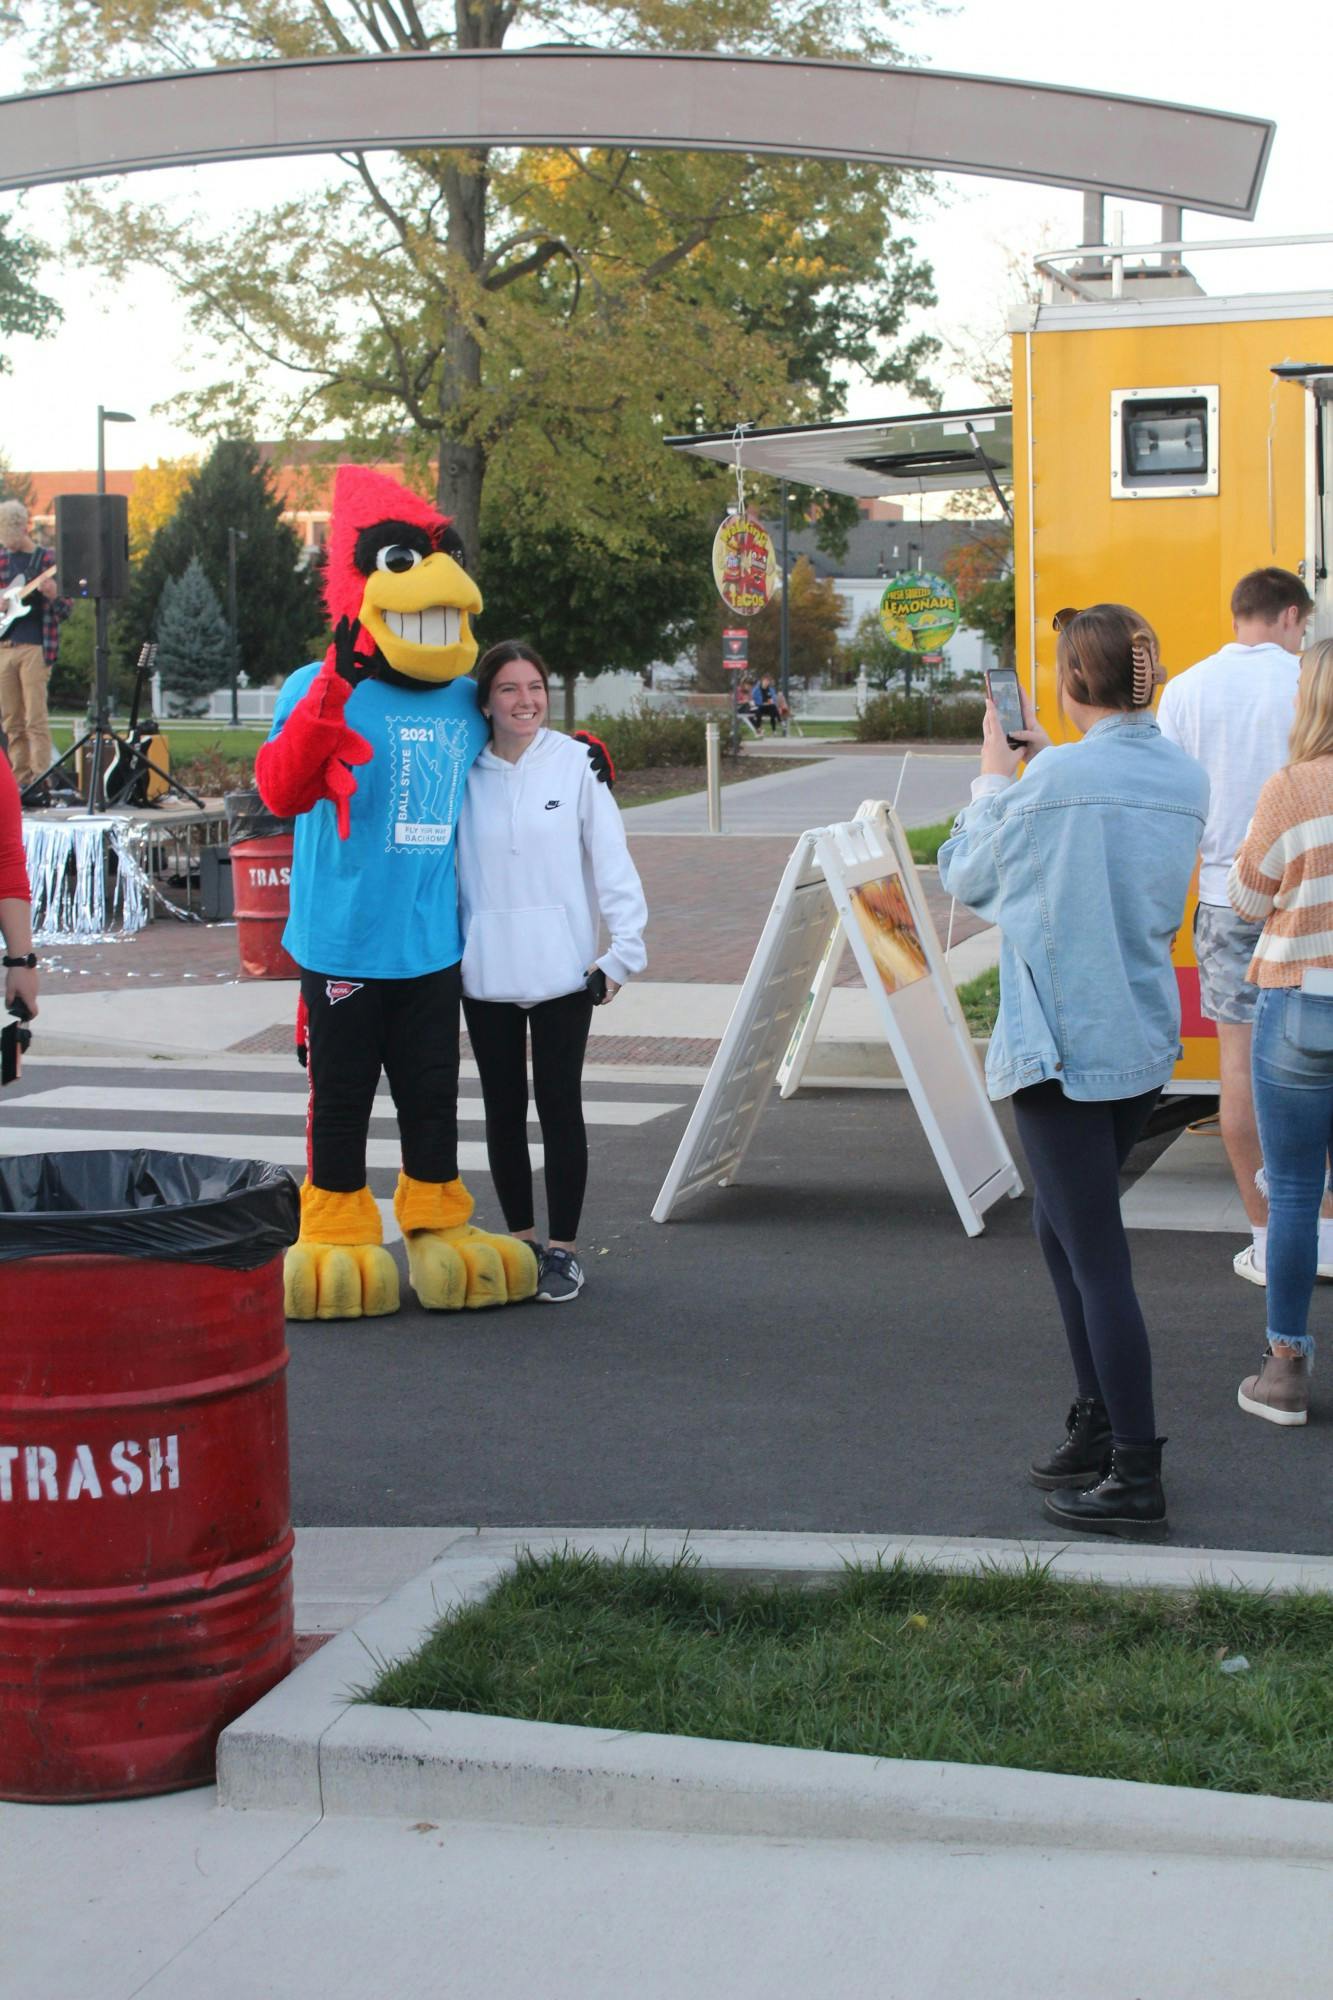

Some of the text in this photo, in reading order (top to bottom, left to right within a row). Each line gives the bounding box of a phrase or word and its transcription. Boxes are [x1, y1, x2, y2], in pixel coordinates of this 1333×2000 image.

[883, 597, 956, 615] LEMONADE
[400, 727, 434, 742] 2021
[398, 749, 411, 821] BALL STATE
[405, 834, 425, 842] BAC
[248, 867, 291, 887] TRAS
[0, 1434, 180, 1501] TRASH
